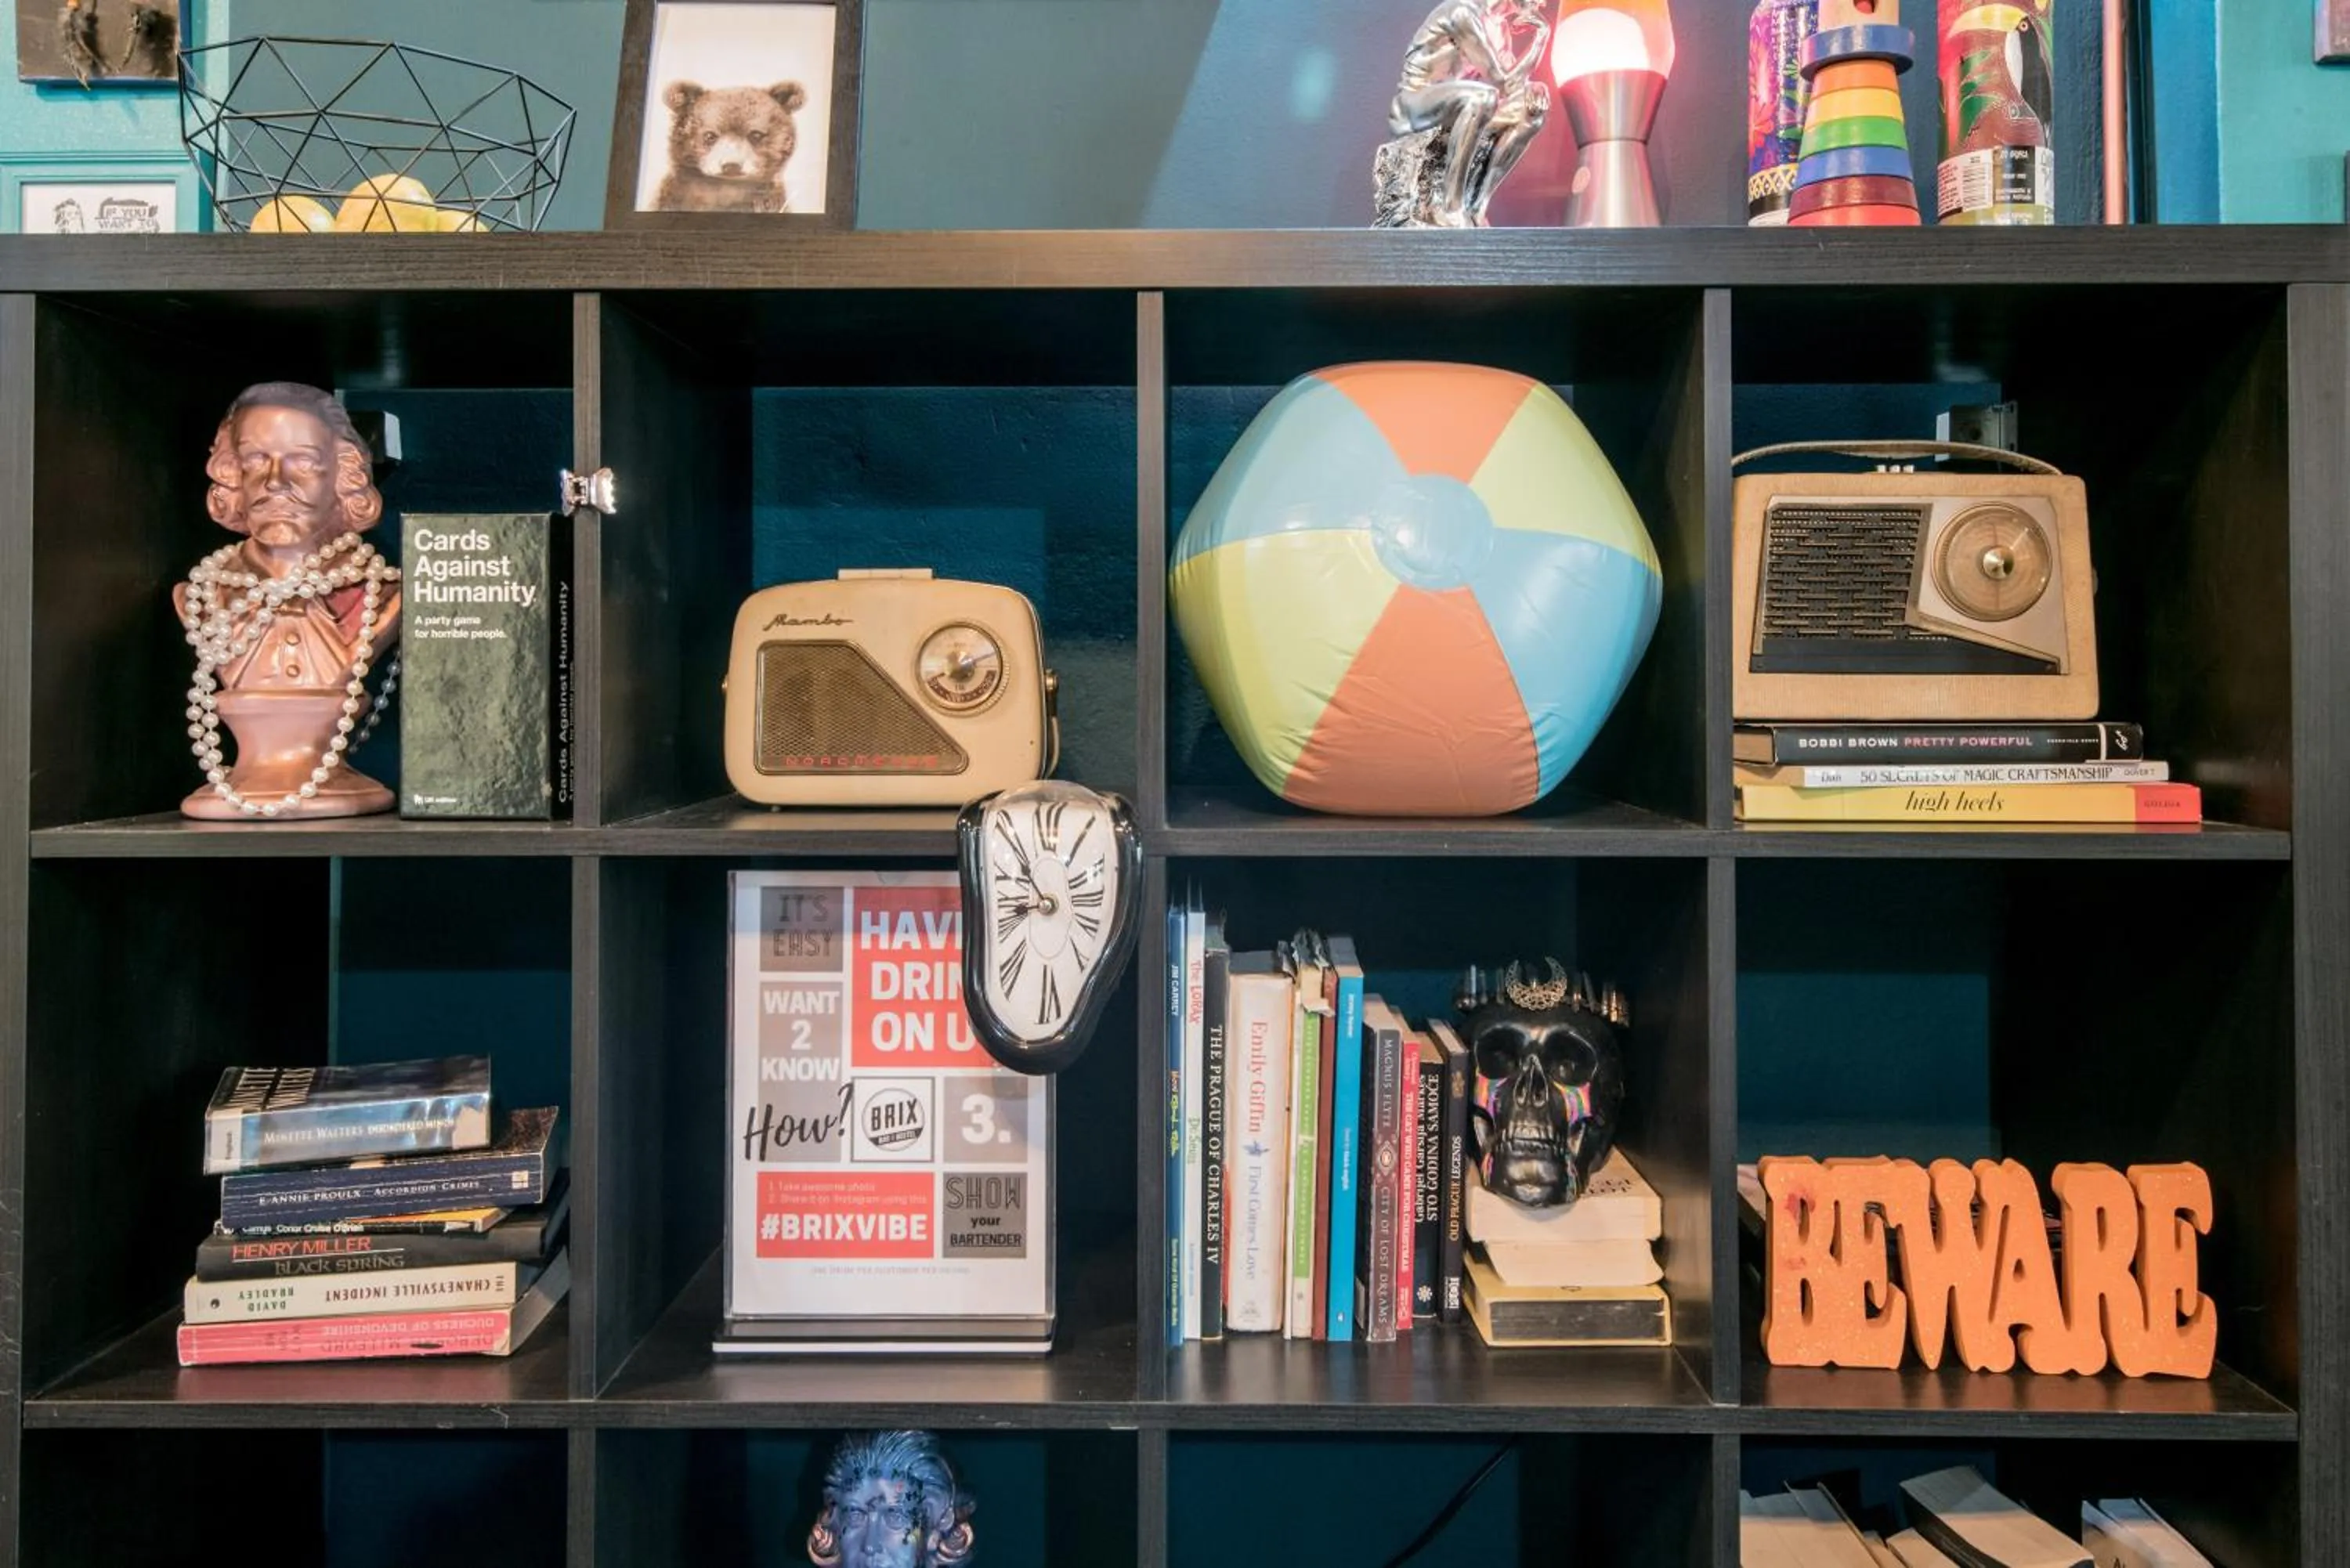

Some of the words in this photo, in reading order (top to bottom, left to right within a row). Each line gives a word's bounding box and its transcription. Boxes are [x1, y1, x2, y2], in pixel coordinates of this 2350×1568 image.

[121, 208, 146, 218] YOU
[414, 529, 490, 551] Cards
[414, 555, 511, 582] Against
[414, 615, 422, 625] A
[425, 616, 450, 627] party
[454, 617, 481, 627] game
[414, 629, 429, 638] for
[431, 629, 468, 638] horrible
[559, 581, 569, 668] Humanity
[762, 613, 854, 631] Mambo
[559, 674, 569, 742] Against
[1799, 738, 1842, 748] BOBBI
[1848, 738, 1899, 748] BROWN
[1904, 737, 1954, 747] PRETTY
[1960, 736, 2034, 747] POWERFUL
[559, 749, 568, 803] Cards
[1860, 771, 1877, 783] 50
[1964, 768, 2002, 782] MAGIC
[2008, 767, 2113, 781] CRAFTSMANSHIP
[1905, 790, 1949, 812] high
[1955, 790, 2005, 811] heels
[779, 894, 827, 923] IT'S
[773, 928, 833, 957] EASY
[871, 962, 965, 1000] DRI
[1190, 960, 1202, 982] The
[764, 991, 840, 1014] WANT
[1188, 985, 1203, 1025] LORAX
[790, 1020, 812, 1050] 2
[871, 1012, 935, 1052] ON
[946, 1013, 977, 1052] U
[1210, 1024, 1223, 1060] THE
[1247, 1021, 1267, 1076] Emily
[761, 1057, 840, 1082] KNOW
[1383, 1039, 1393, 1088] MAGNUS
[1209, 1065, 1222, 1133] PRAGUE
[1249, 1080, 1267, 1133] Giffin
[1382, 1093, 1392, 1128] FLYTE
[1425, 1074, 1439, 1132] SAMOĆE
[743, 1082, 853, 1162] How?
[871, 1098, 918, 1132] BRIX
[961, 1093, 1012, 1145] 3.
[315, 1125, 363, 1140] WALTERS
[1416, 1123, 1426, 1169] Garsija
[1208, 1137, 1221, 1159] OF
[1426, 1134, 1438, 1190] GODINA
[1452, 1136, 1461, 1179] LEGENDS
[1248, 1165, 1262, 1196] First
[1403, 1161, 1412, 1187] CAME
[272, 1193, 308, 1204] ANNIE
[314, 1190, 362, 1201] PROULX
[374, 1184, 436, 1197] ACCORDION
[442, 1181, 479, 1191] CRIMES
[945, 1177, 1021, 1210] SHOW
[1206, 1164, 1220, 1241] CHARLES
[1381, 1187, 1390, 1215] CITY
[1415, 1174, 1426, 1223] Gabrijel
[1450, 1180, 1460, 1217] PRAGUE
[1247, 1199, 1260, 1243] Comes
[1426, 1194, 1438, 1221] STO
[277, 1223, 302, 1233] Conor
[303, 1223, 331, 1234] Cruise
[760, 1213, 927, 1241] #BRIXVIBE
[971, 1216, 1001, 1229] your
[1380, 1219, 1389, 1234] OF
[1449, 1219, 1459, 1241] OLD
[232, 1241, 298, 1259] HENRY
[302, 1236, 371, 1254] MILLER
[950, 1234, 1021, 1246] BARTENDER
[1206, 1246, 1219, 1264] IV
[1246, 1247, 1260, 1281] Love
[1379, 1240, 1390, 1269] LOST
[1757, 1155, 2217, 1379] BEWARE
[237, 1286, 295, 1299] BRADLEY
[324, 1286, 387, 1302] INCIDENT
[394, 1279, 490, 1298] CHANEYSVILLE
[1376, 1274, 1389, 1323] DREAMS
[247, 1300, 287, 1313] DAVID
[324, 1322, 407, 1336] DEVONSHIRE
[412, 1321, 429, 1331] OF
[433, 1317, 495, 1331] DUCHESS
